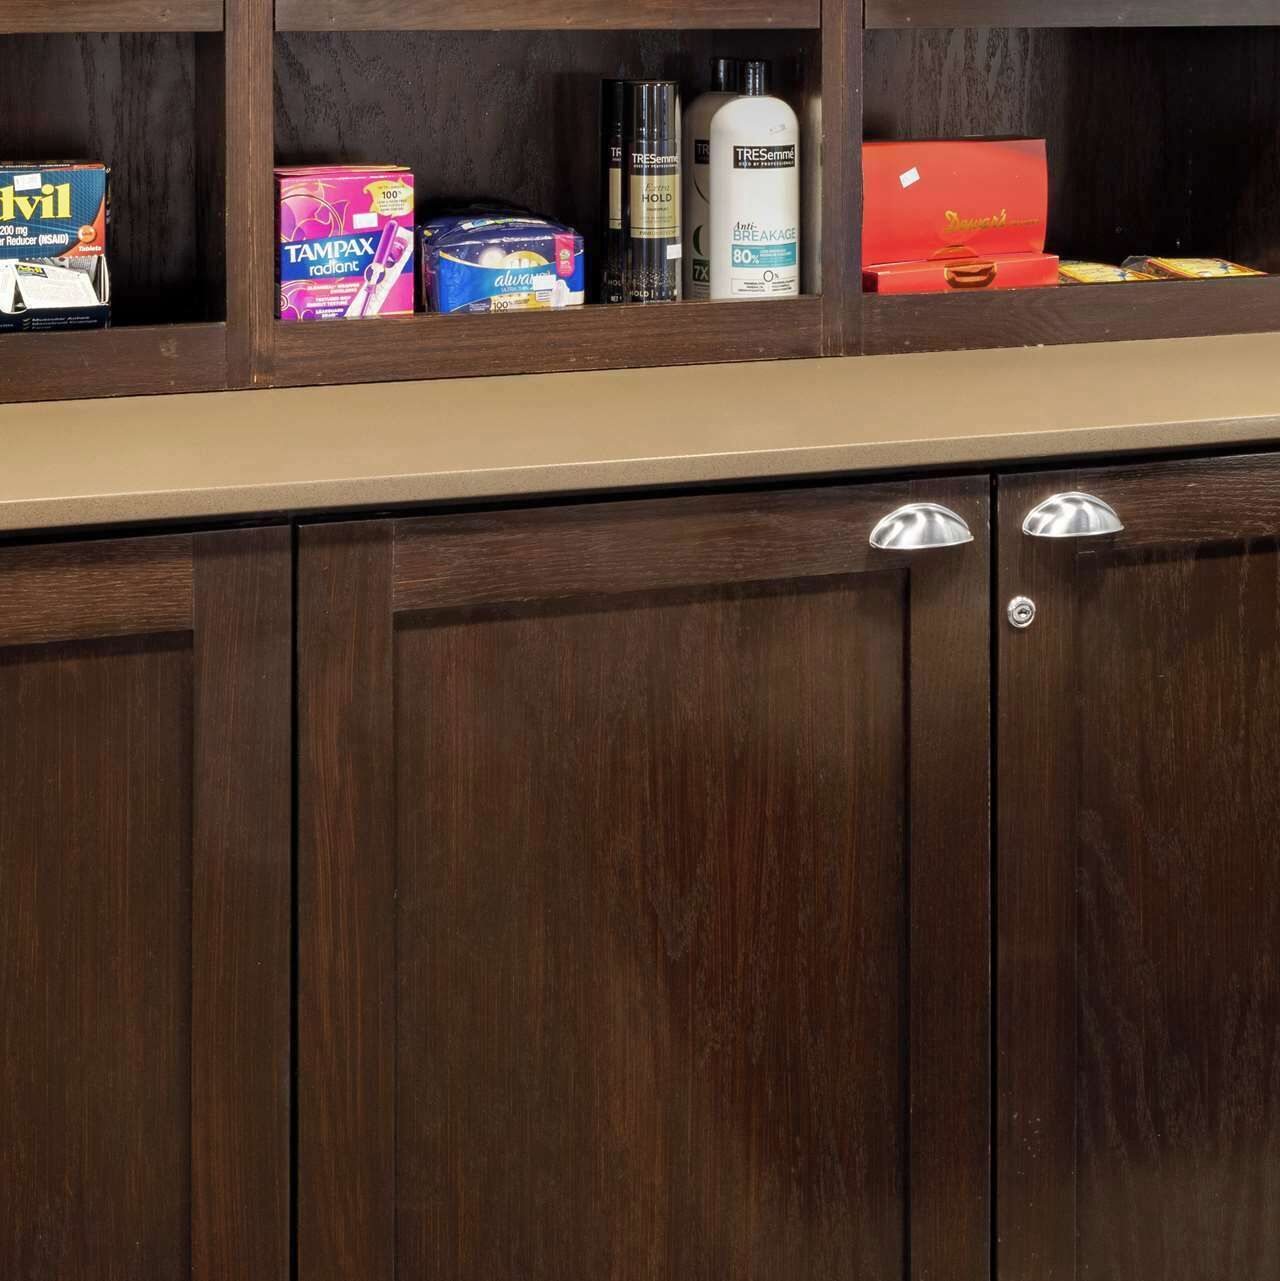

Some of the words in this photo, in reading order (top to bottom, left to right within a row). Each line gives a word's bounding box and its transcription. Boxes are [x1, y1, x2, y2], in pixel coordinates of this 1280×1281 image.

[735, 145, 795, 161] TRESemmé
[641, 193, 673, 204] HOLD
[0, 225, 15, 236] 200
[15, 226, 29, 238] mg
[733, 227, 797, 242] BREAKAGE
[7, 235, 38, 246] Reducer
[38, 233, 70, 246] (NSAID)
[284, 236, 375, 263] TAMPAX
[732, 248, 760, 265] 80%
[309, 260, 360, 277] radiant
